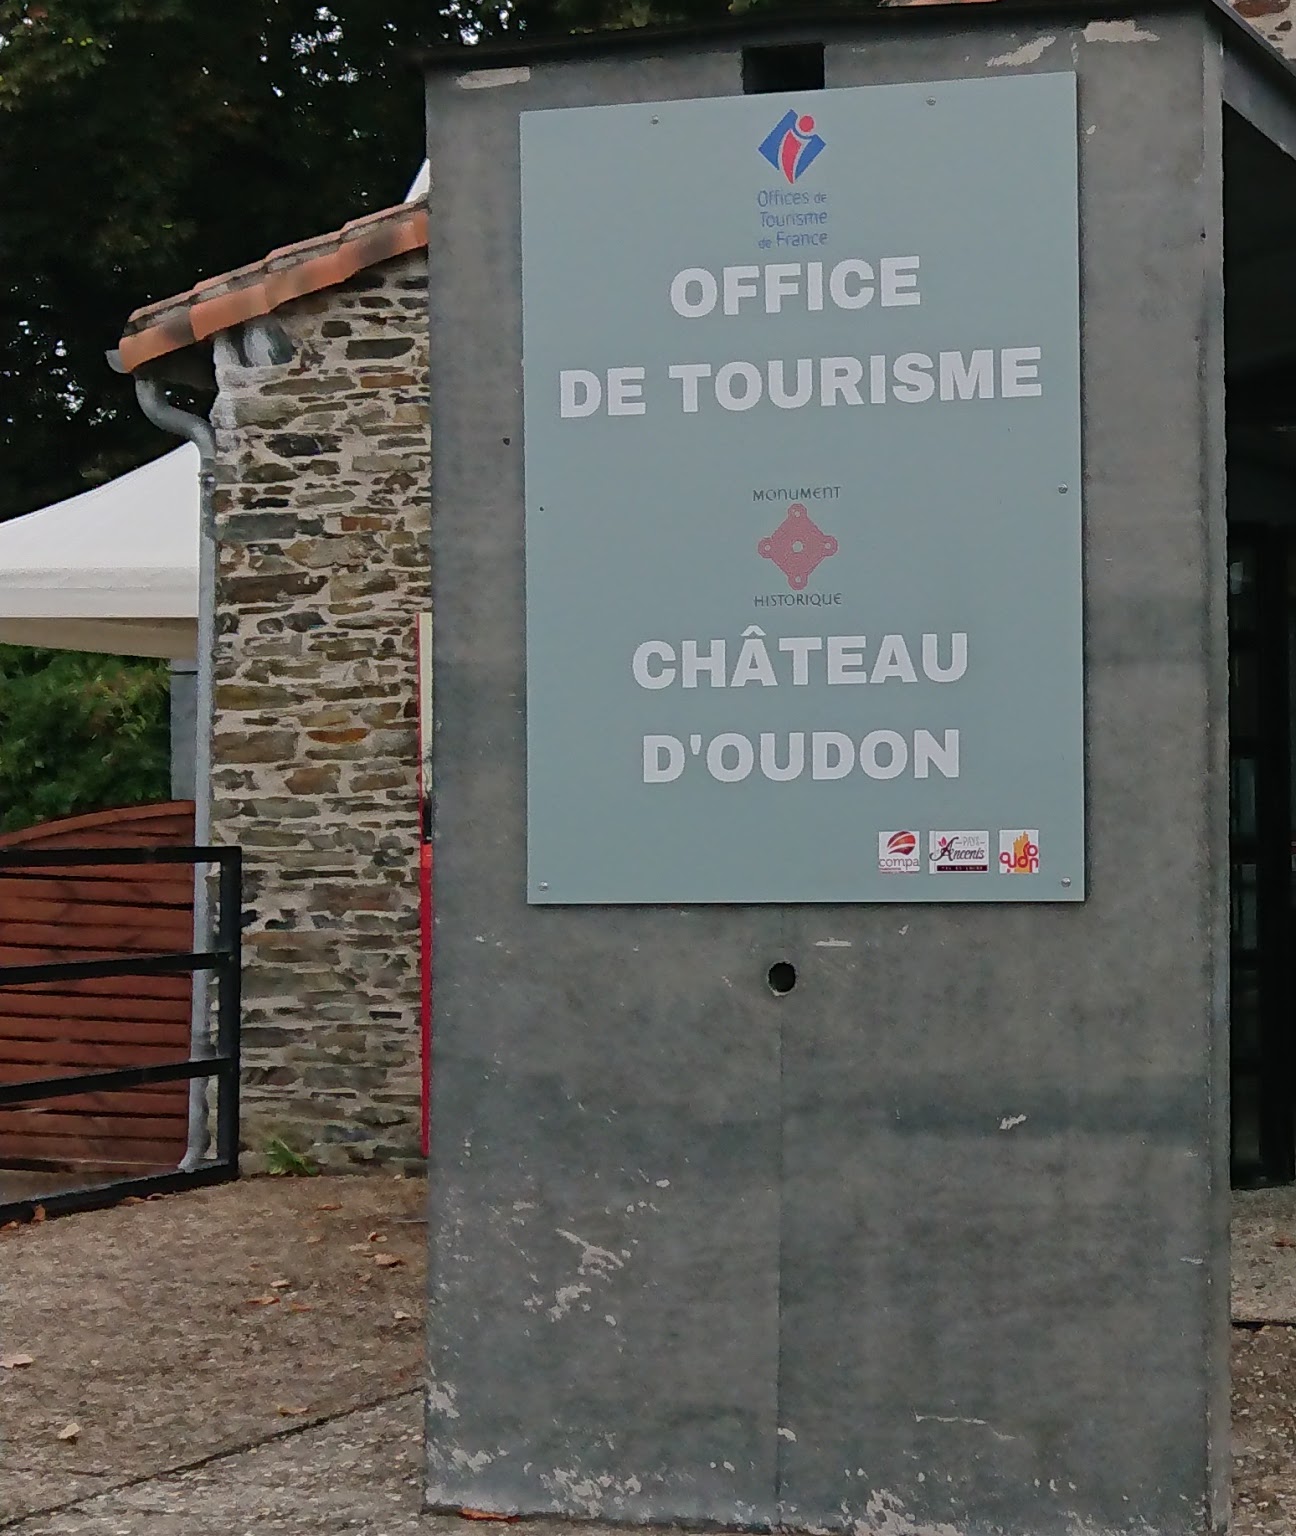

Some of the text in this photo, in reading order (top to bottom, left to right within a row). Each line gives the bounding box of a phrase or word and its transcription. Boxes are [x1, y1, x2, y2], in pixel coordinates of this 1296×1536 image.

[757, 190, 827, 207] Offices de
[759, 211, 828, 228] Tourisme
[758, 231, 828, 249] de France
[669, 255, 921, 318] OFFICE
[559, 347, 1043, 418] DE TOURISME
[752, 486, 842, 502] MONUMENT
[753, 592, 843, 608] HISTORIQUE
[631, 625, 969, 690] CHÂTEAU
[643, 729, 959, 783] D'OUDON
[929, 836, 985, 862] Ancenis
[879, 857, 919, 869] compa
